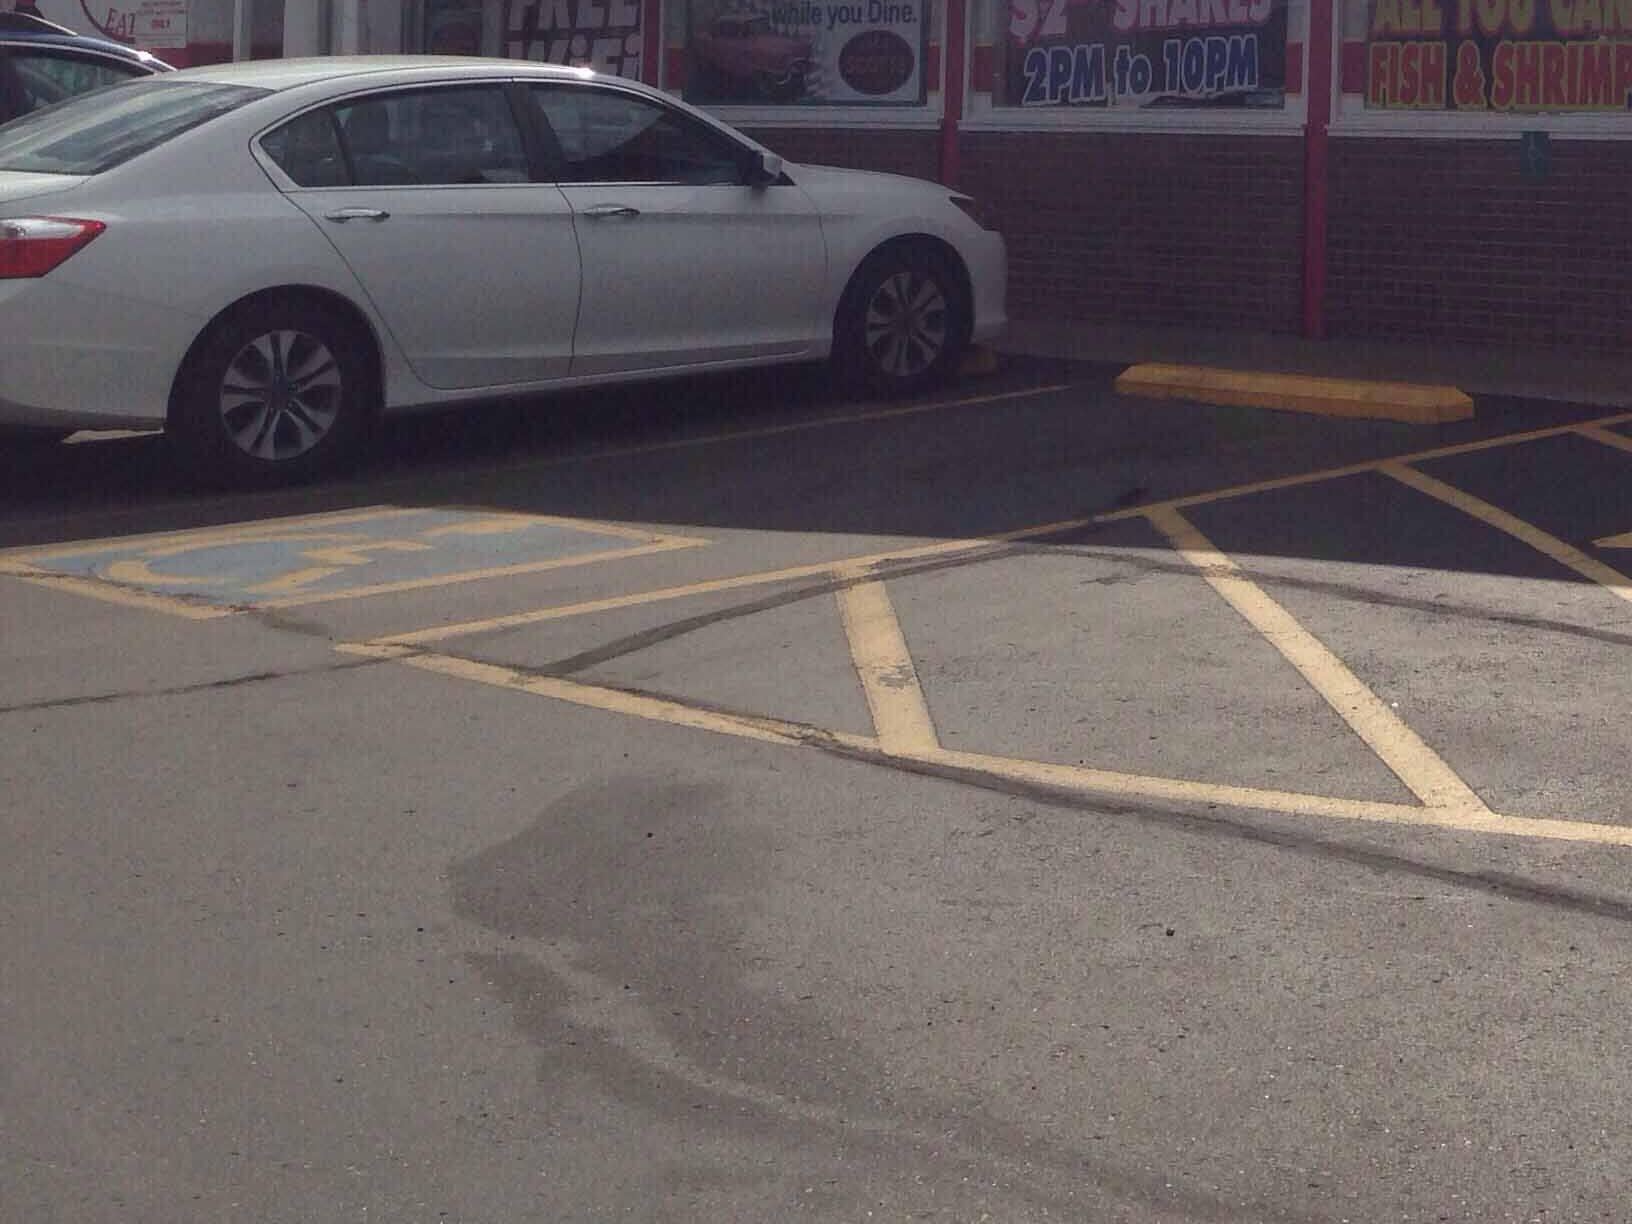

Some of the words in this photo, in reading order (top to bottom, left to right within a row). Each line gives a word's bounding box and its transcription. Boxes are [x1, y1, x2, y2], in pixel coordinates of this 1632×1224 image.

[770, 1, 823, 24] while
[828, 6, 862, 29] you
[868, 0, 918, 24] Dine.
[1022, 43, 1107, 106] 2PM
[1113, 44, 1153, 97] to
[1163, 33, 1259, 95] 10PM
[1368, 40, 1447, 109] FISH
[1453, 39, 1487, 110] &
